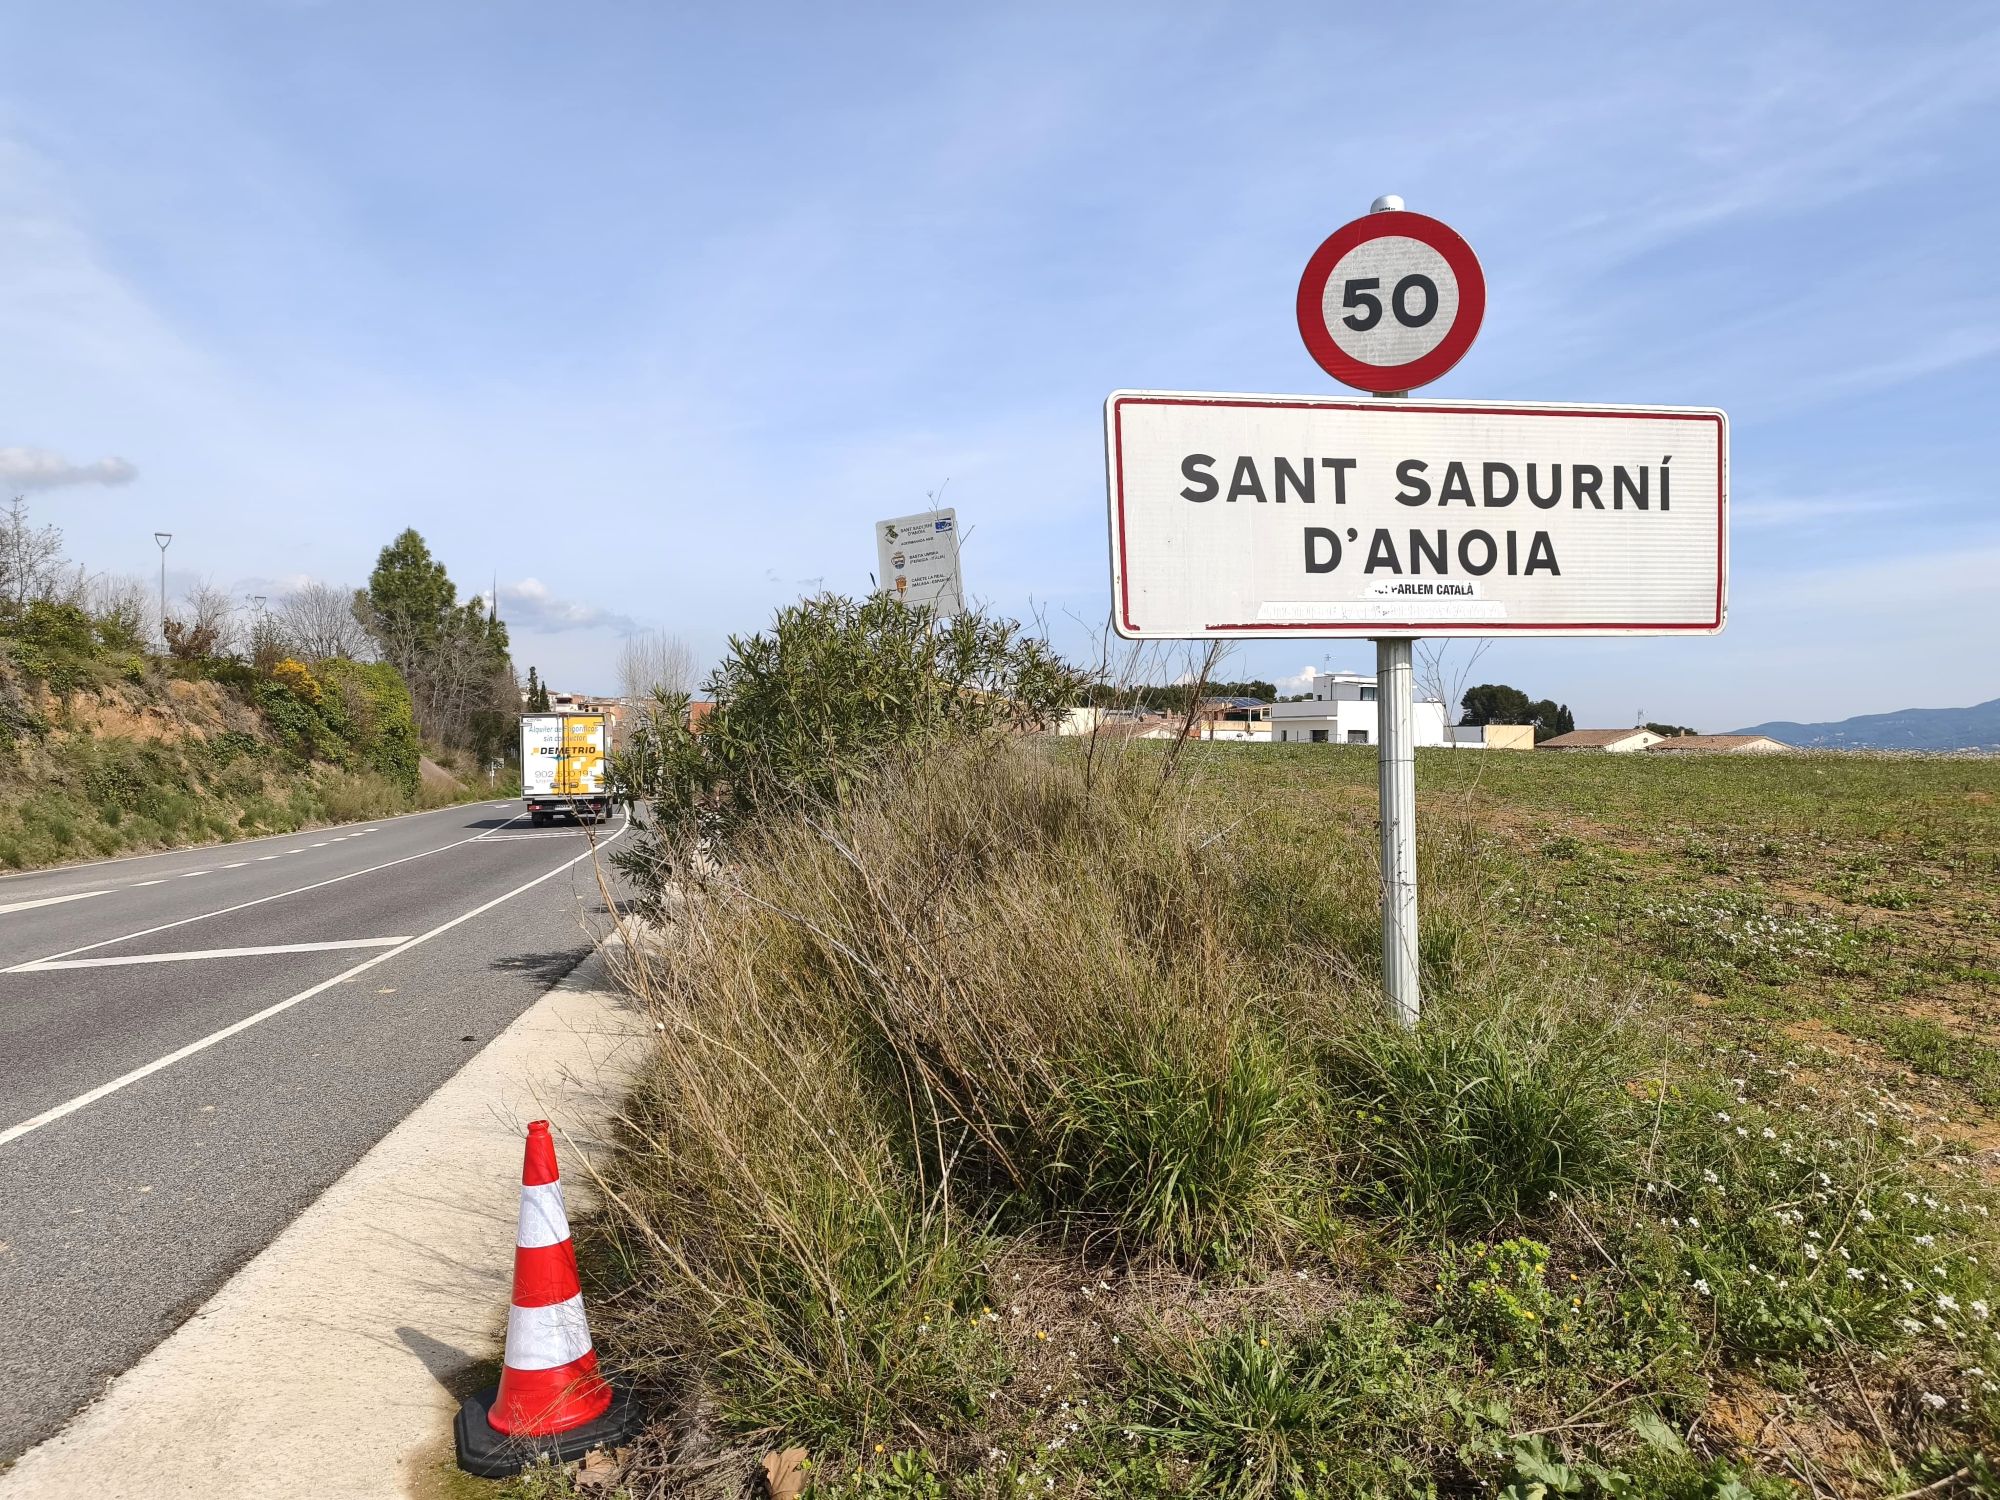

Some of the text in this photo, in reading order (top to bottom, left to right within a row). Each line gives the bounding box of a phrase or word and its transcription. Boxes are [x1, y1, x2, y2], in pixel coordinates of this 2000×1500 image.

[1342, 273, 1439, 332] 50
[1180, 454, 1673, 511] SANT SADURNÍ
[1304, 527, 1561, 576] D'ANOIA
[1436, 582, 1474, 595] CATALÀ
[540, 746, 596, 755] DEMETRIO
[535, 770, 554, 778] 902
